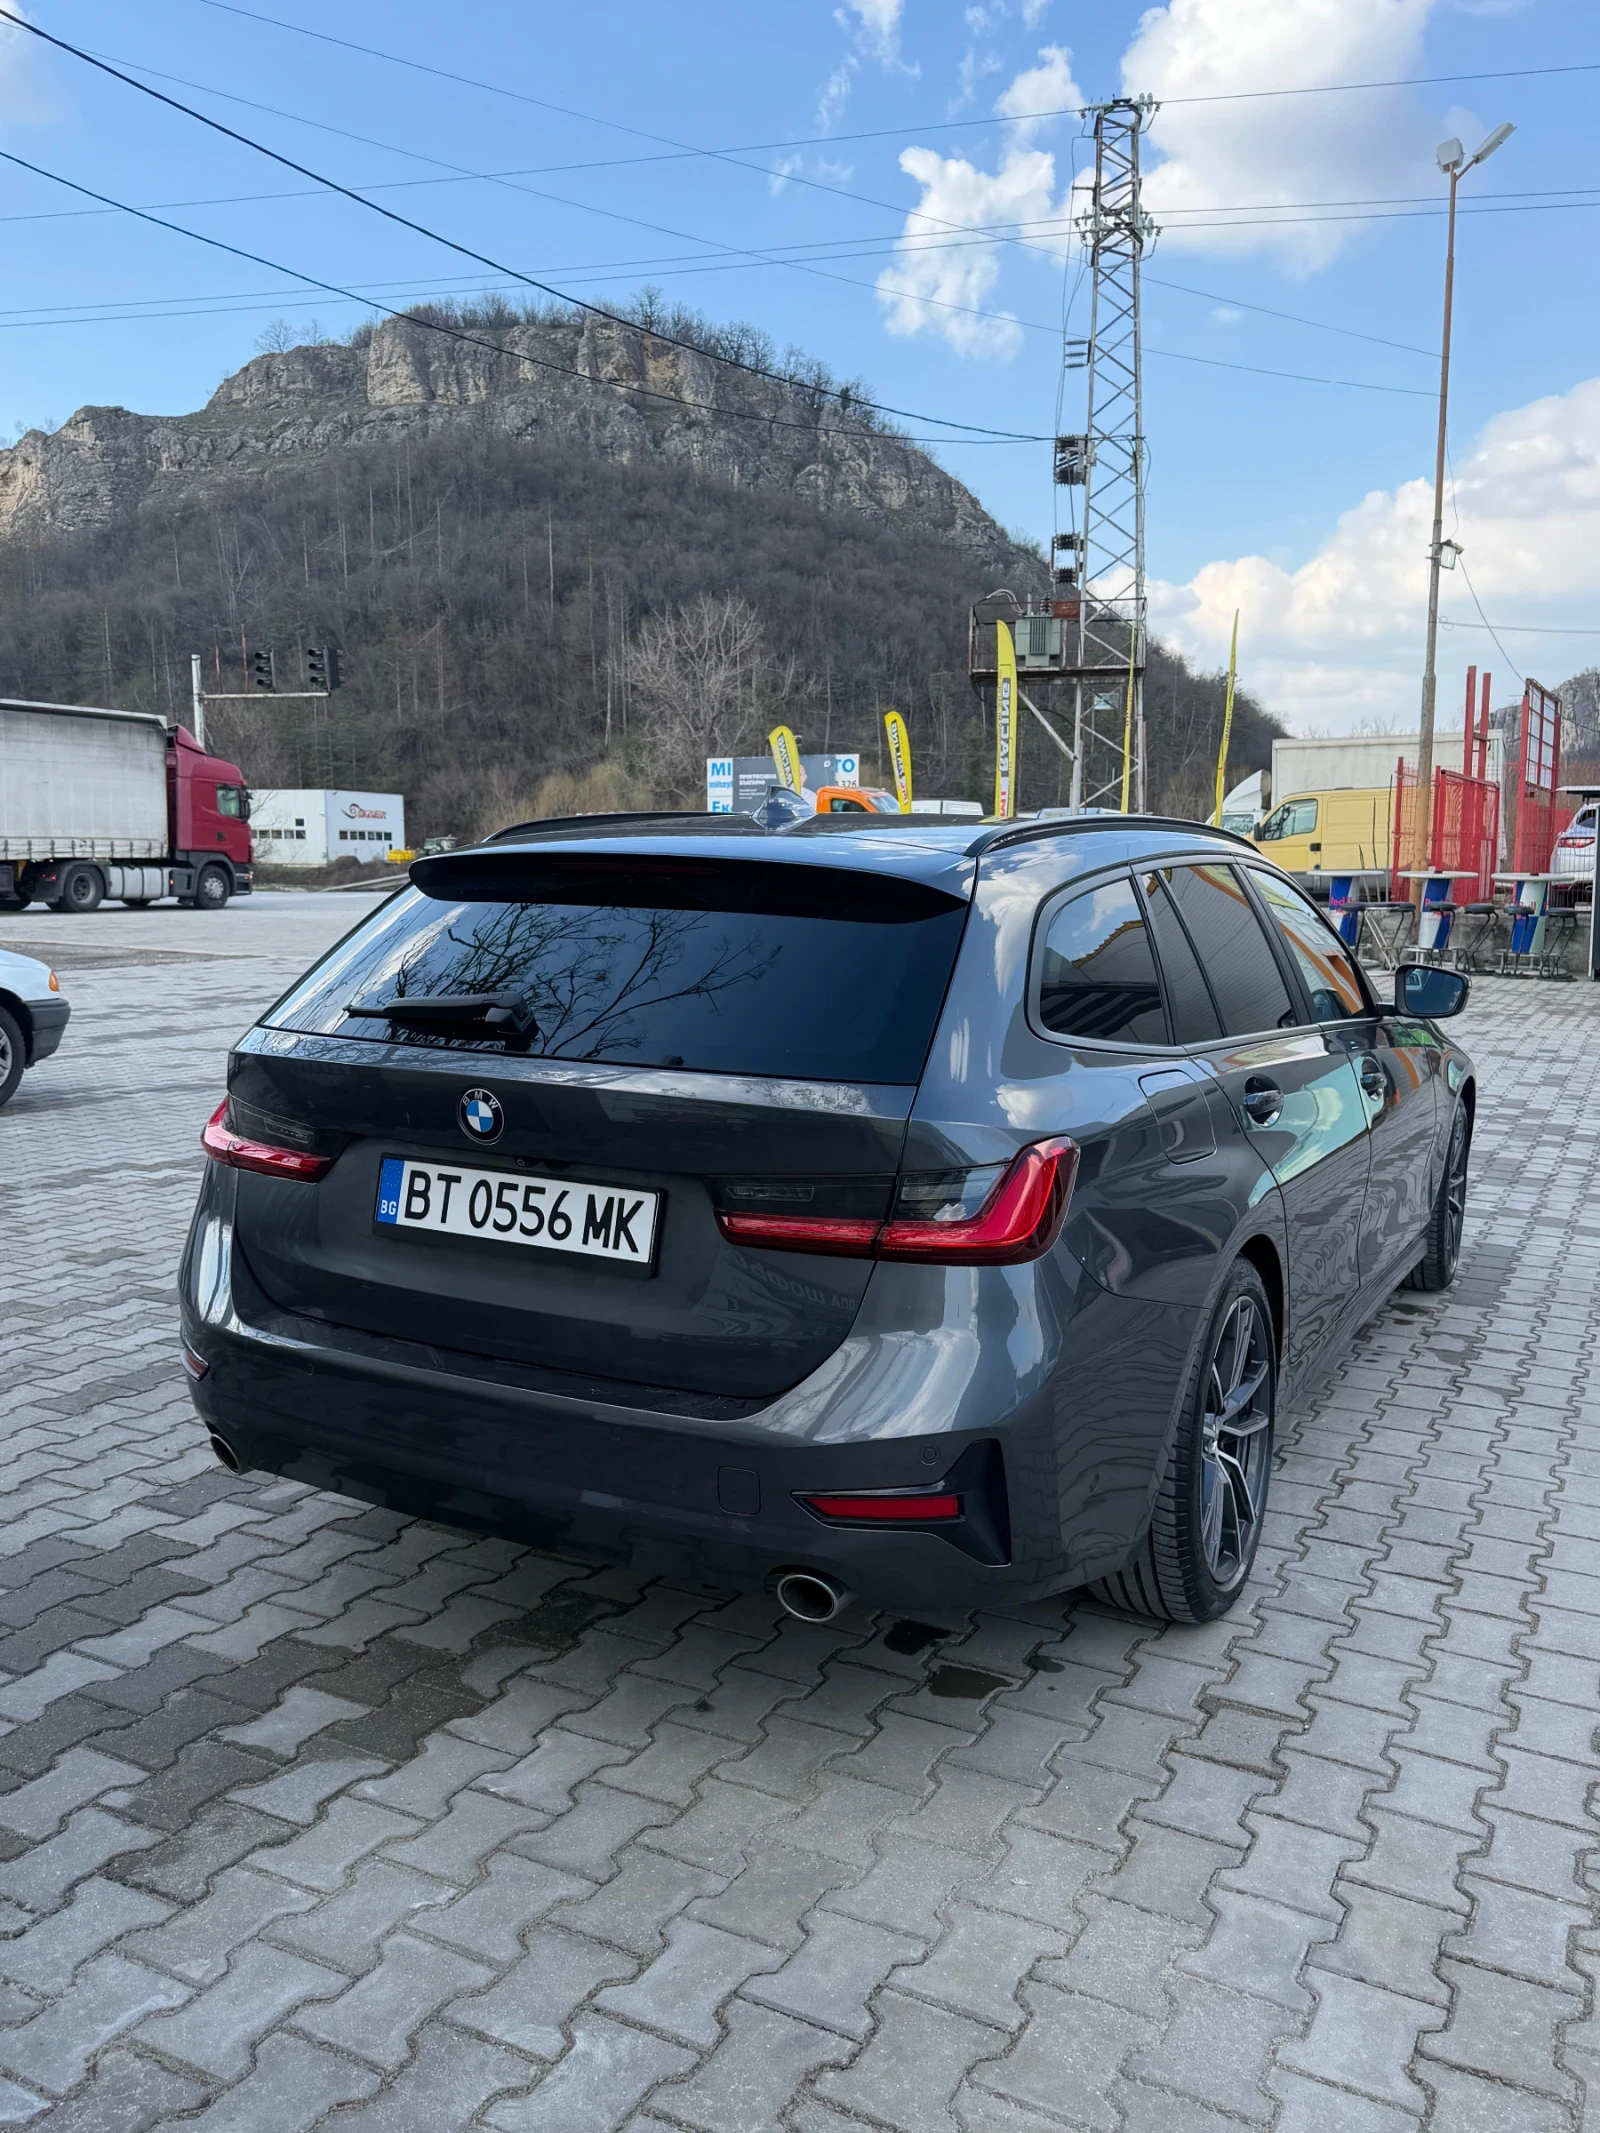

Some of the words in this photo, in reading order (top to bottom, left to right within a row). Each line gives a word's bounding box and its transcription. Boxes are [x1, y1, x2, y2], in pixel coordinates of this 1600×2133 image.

[462, 1090, 499, 1109] BMW
[380, 1199, 397, 1216] BG
[404, 1169, 462, 1224] BT
[468, 1178, 573, 1241] 0556
[581, 1193, 645, 1253] MK
